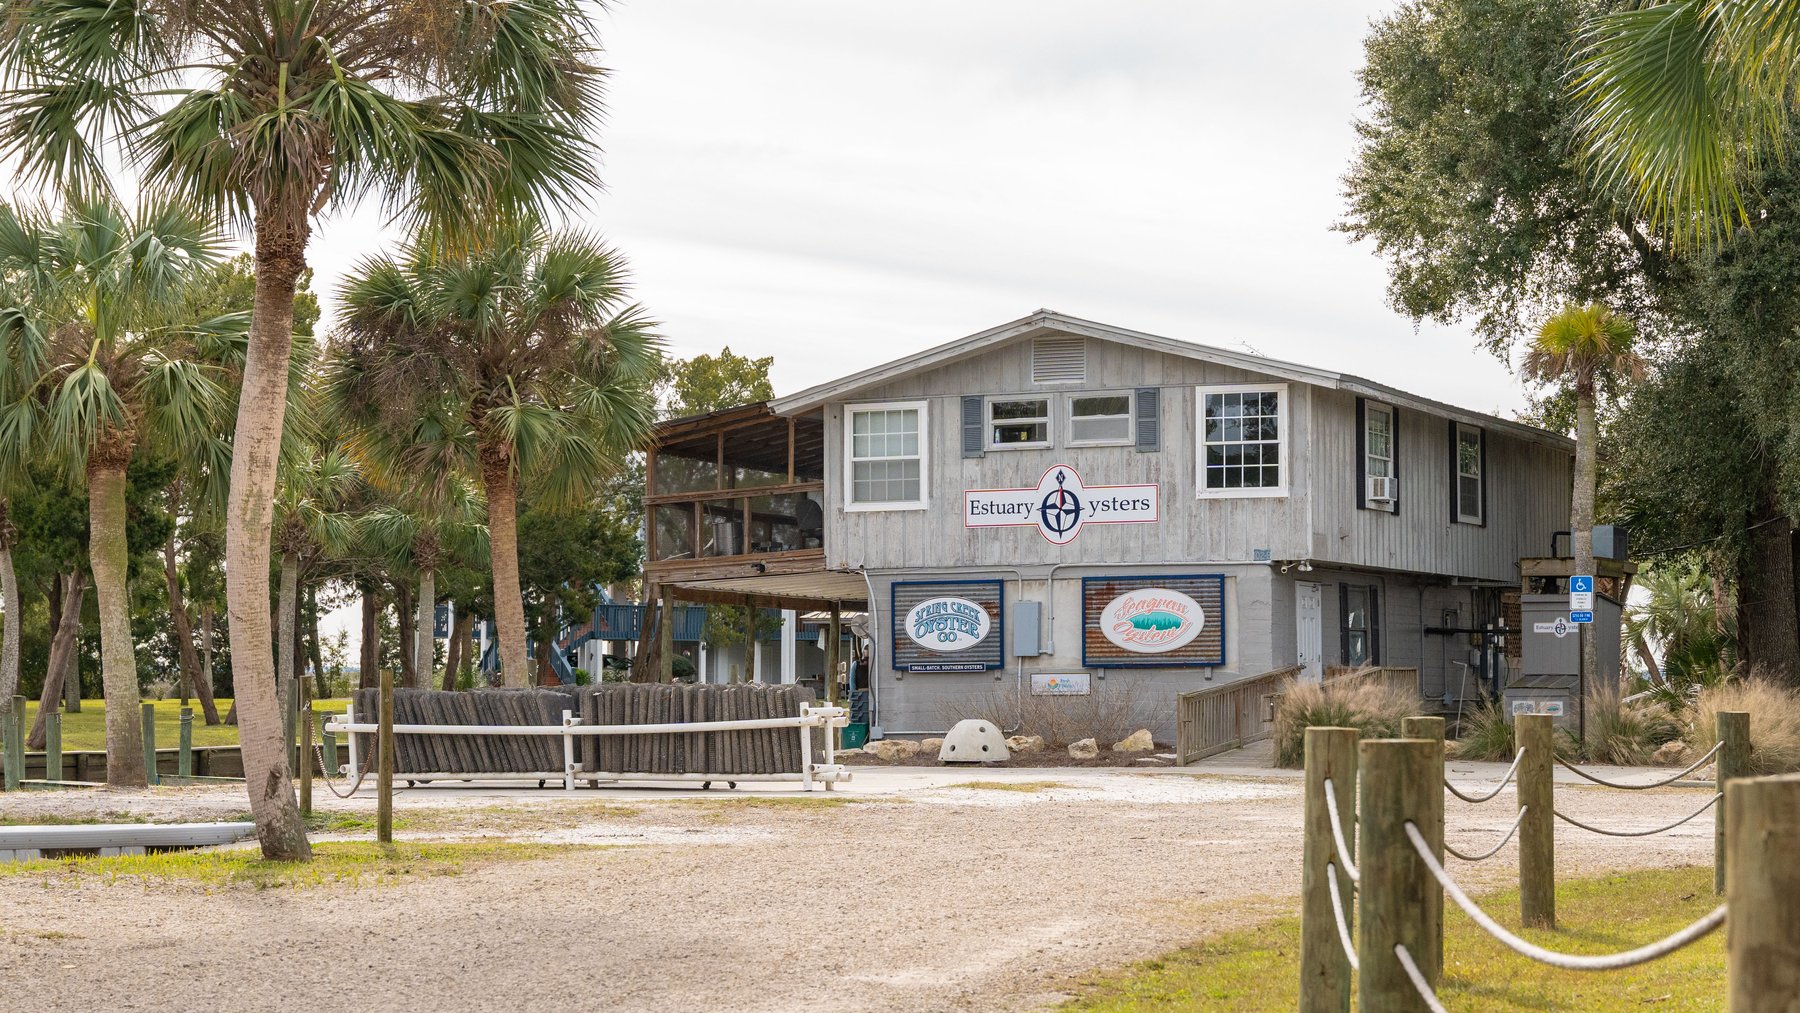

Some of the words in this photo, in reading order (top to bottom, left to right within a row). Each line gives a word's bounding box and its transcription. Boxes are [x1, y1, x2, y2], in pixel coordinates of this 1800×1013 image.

[969, 499, 1035, 519] Estuary
[915, 602, 948, 622] SPRING
[950, 601, 981, 623] CREEK
[1113, 597, 1187, 619] Seagrass
[914, 616, 980, 640] OYSTER
